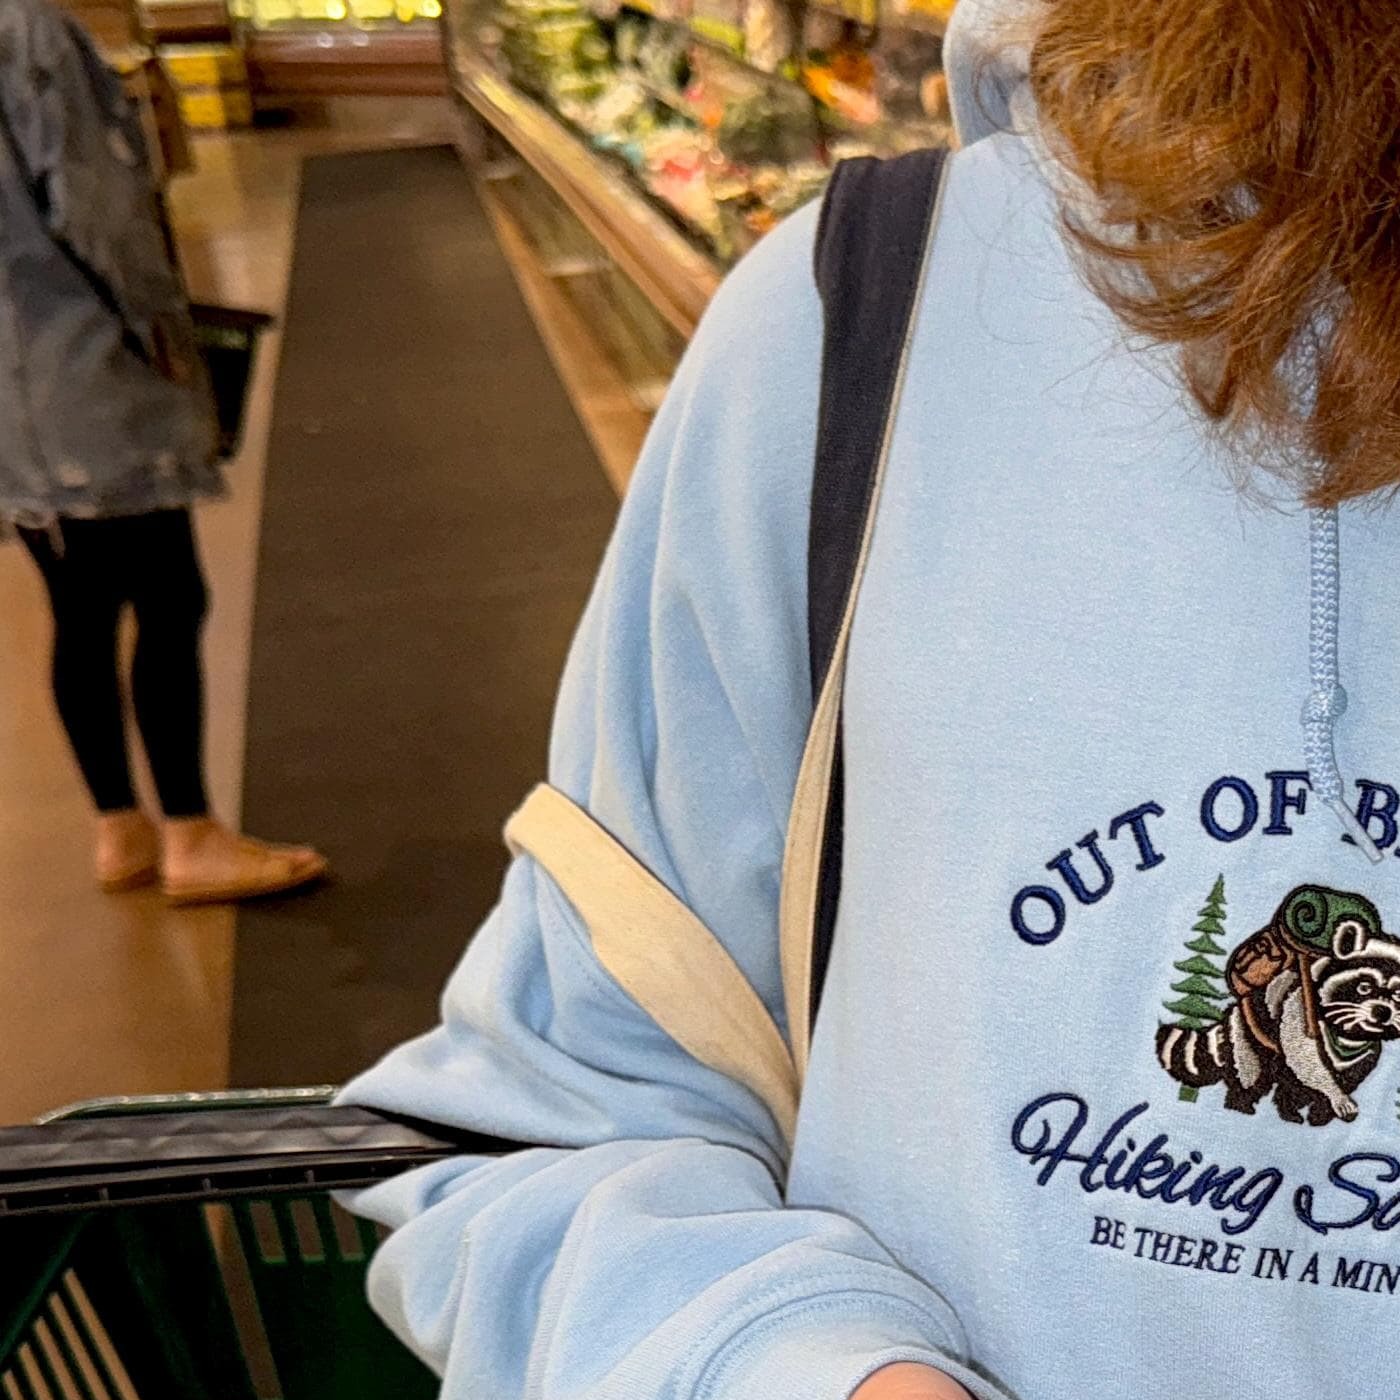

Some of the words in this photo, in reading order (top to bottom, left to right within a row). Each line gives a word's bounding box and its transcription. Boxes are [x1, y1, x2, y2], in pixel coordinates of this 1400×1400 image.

[1009, 801, 1166, 946] OUT
[1200, 771, 1313, 842] OF
[1011, 1092, 1282, 1235] Hiking
[1091, 1217, 1126, 1248] BE
[1133, 1227, 1242, 1274] THERE
[1251, 1249, 1295, 1282] IN
[1301, 1256, 1321, 1285] A
